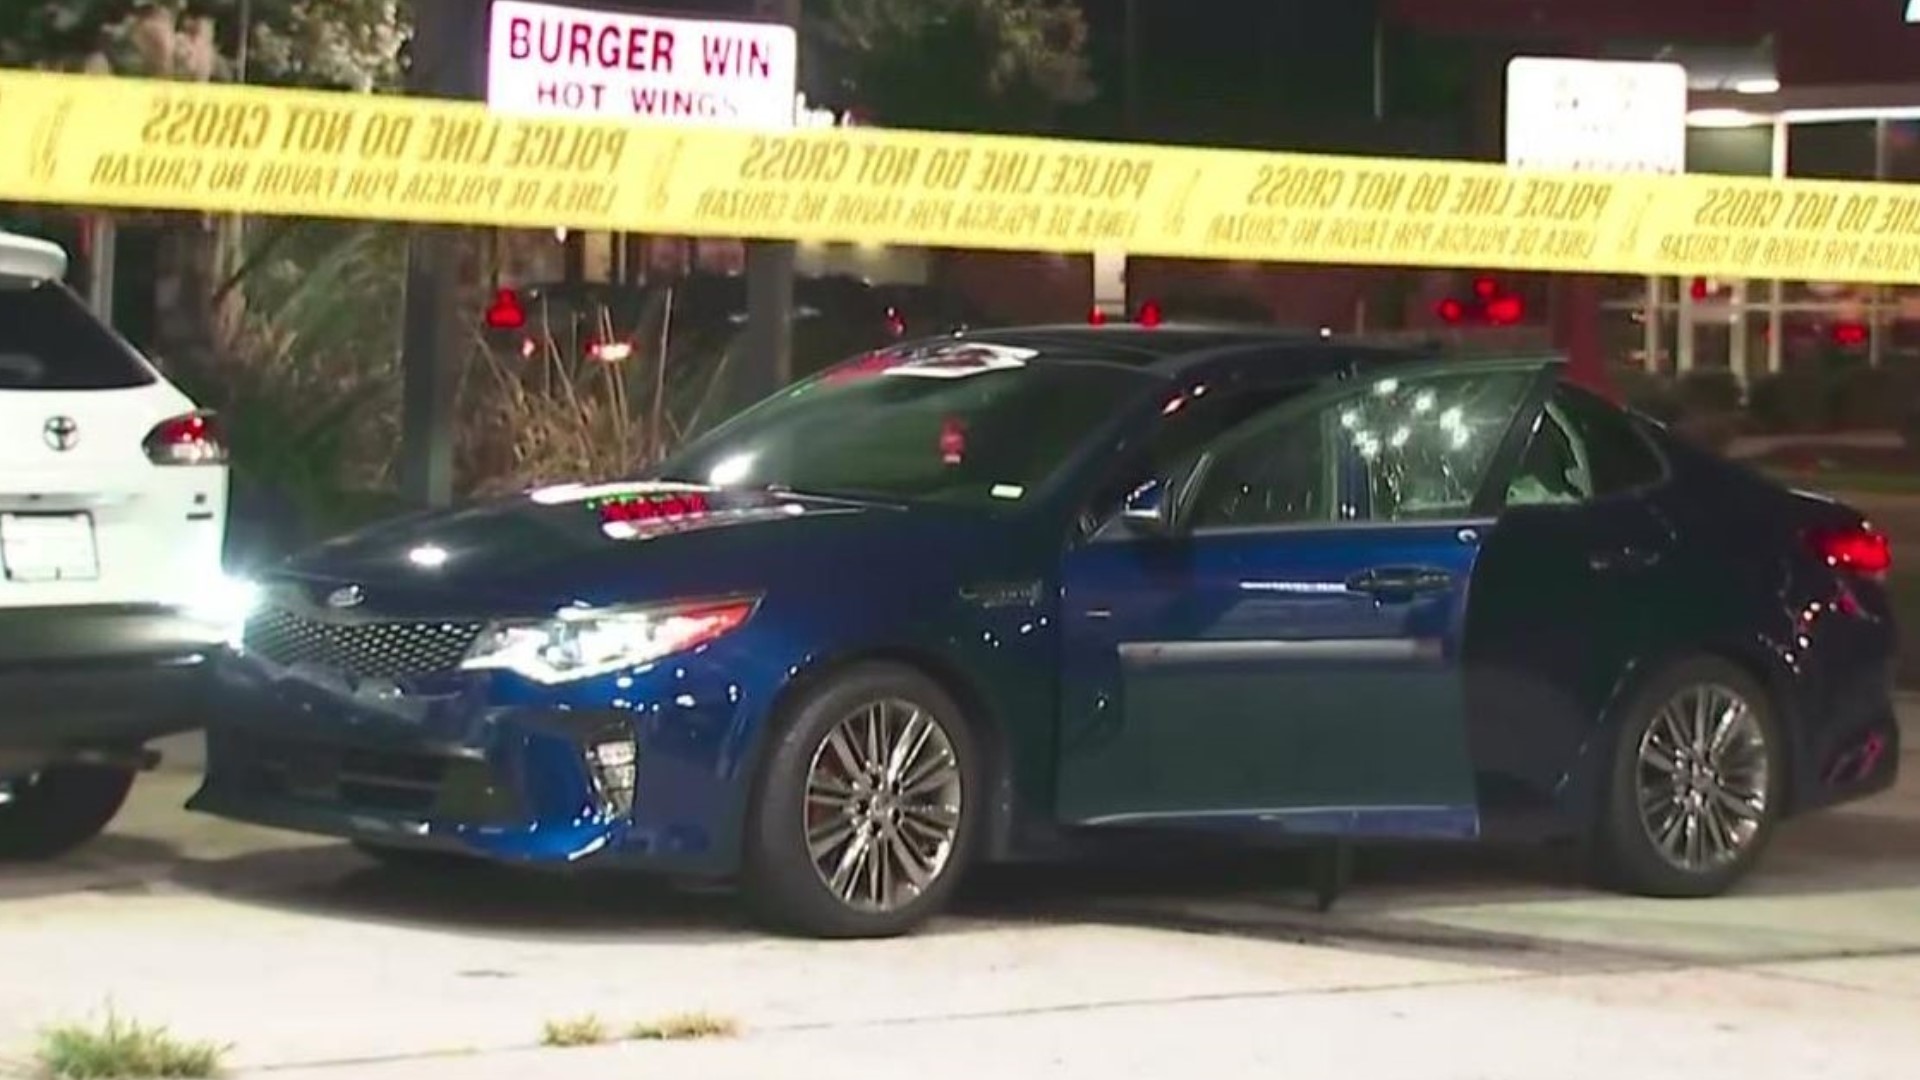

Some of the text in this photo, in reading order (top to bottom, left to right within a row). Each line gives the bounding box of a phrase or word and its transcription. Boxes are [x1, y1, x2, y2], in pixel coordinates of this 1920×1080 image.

[509, 18, 771, 78] BURGER WIN
[536, 81, 606, 110] HOT
